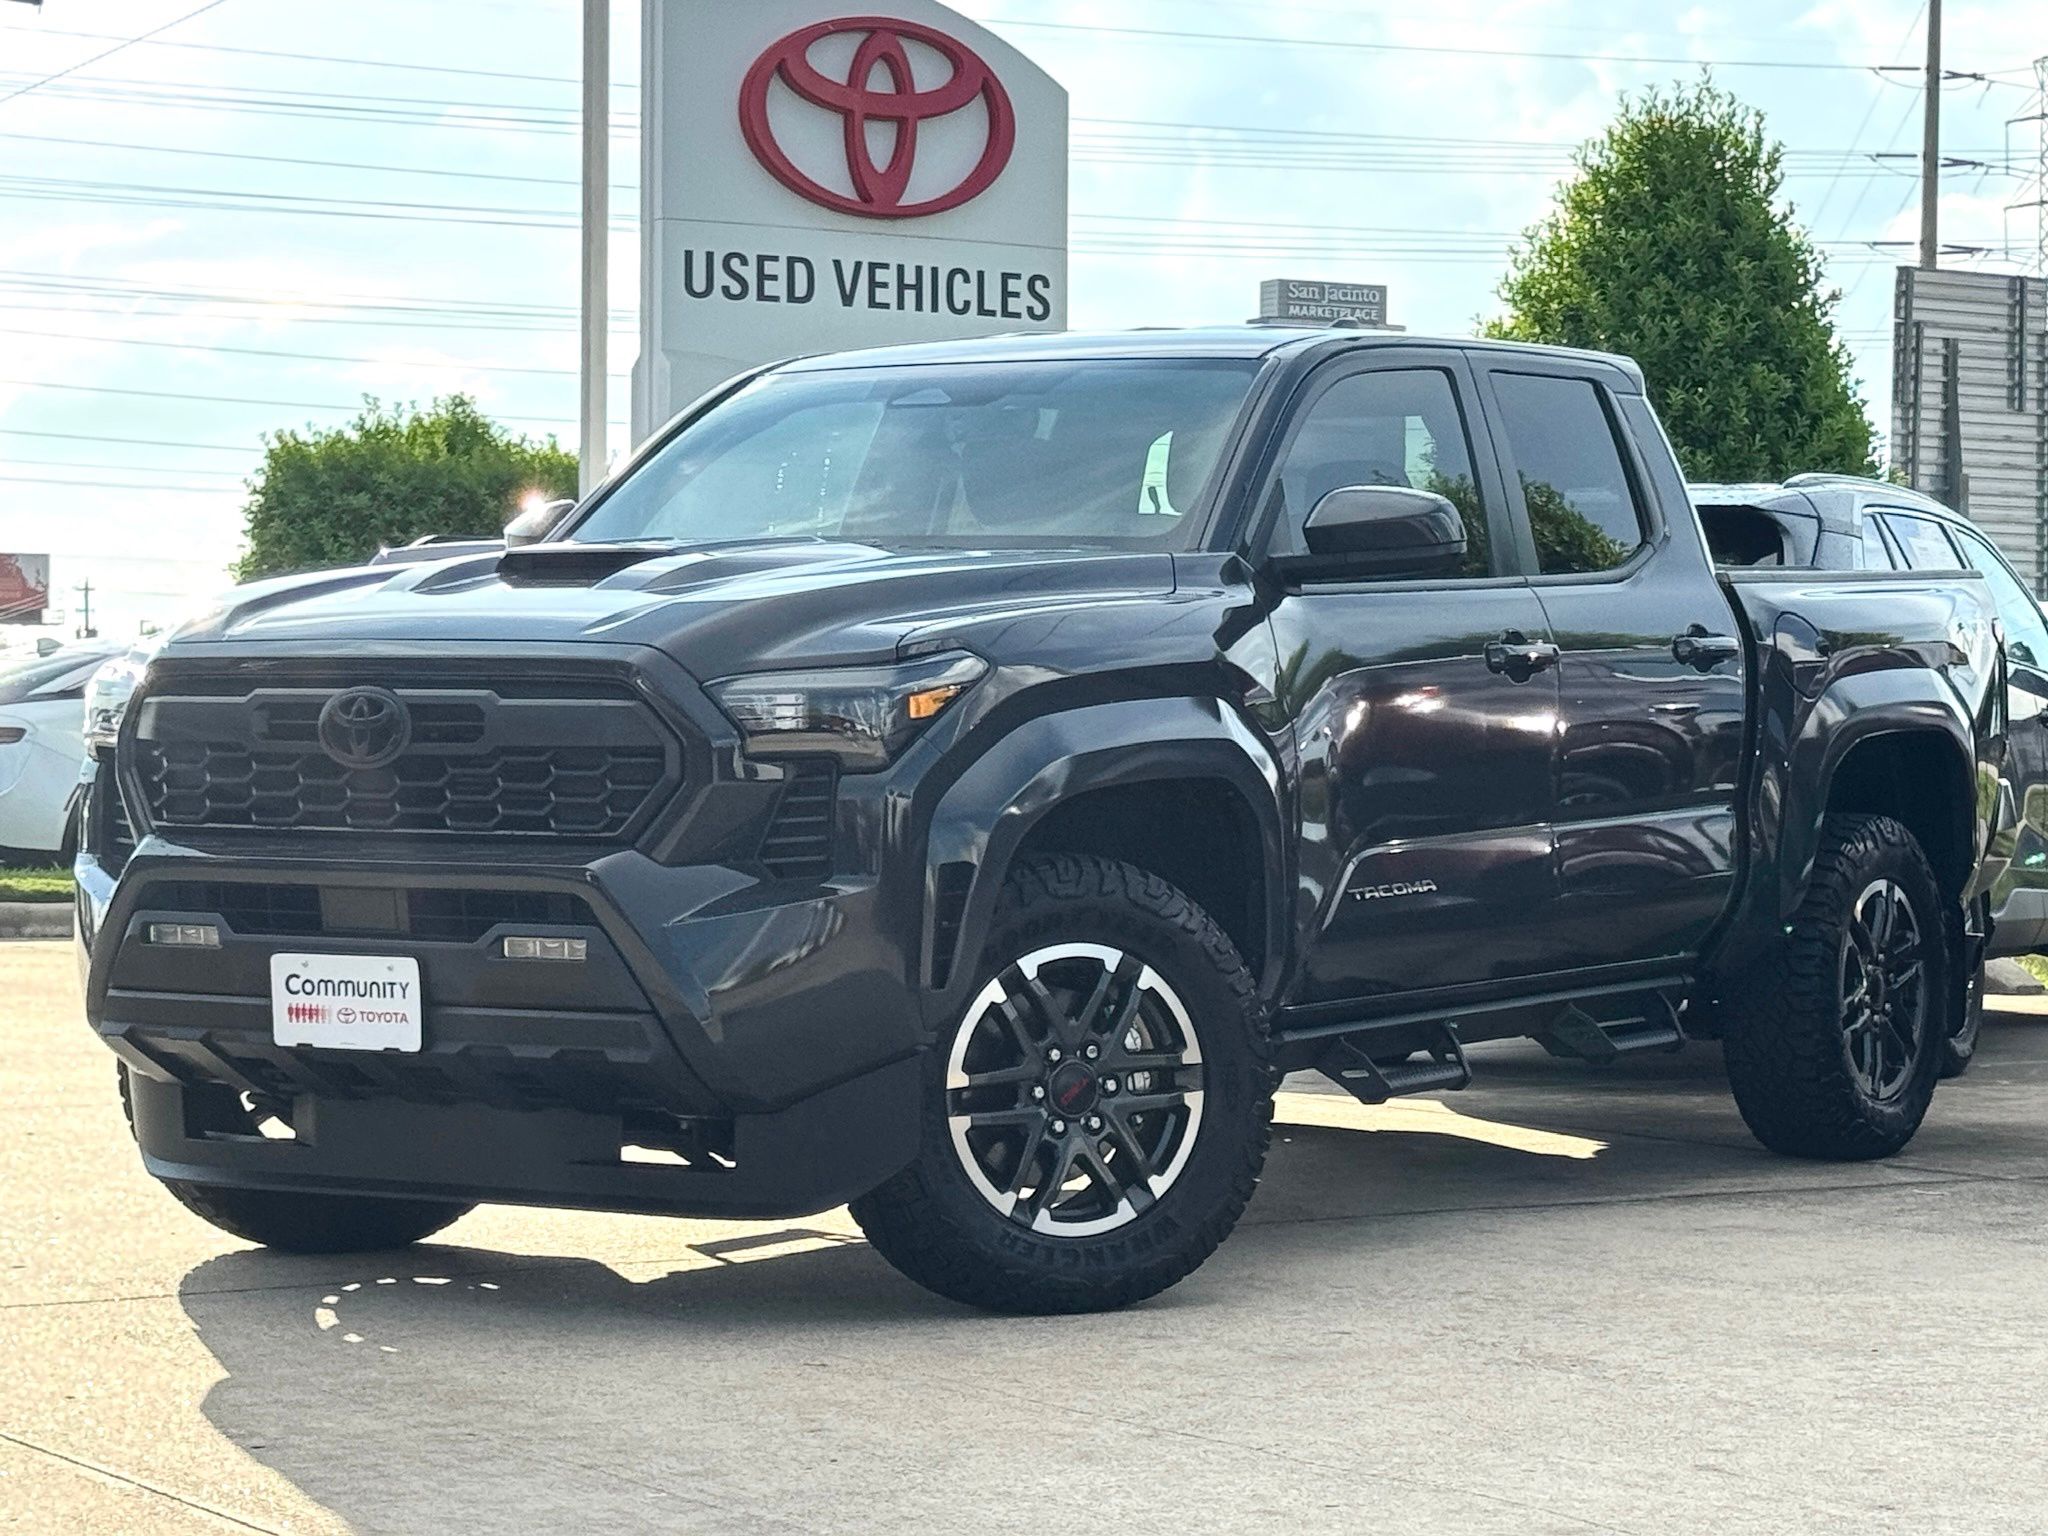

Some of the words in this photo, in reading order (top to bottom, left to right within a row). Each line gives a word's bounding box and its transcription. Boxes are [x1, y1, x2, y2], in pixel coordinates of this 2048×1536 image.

[683, 249, 816, 304] USED
[832, 258, 1051, 321] VEHICLES
[1288, 282, 1320, 299] San
[1321, 284, 1380, 304] Jacinto
[1288, 305, 1379, 320] MARKETPLACE
[1346, 879, 1438, 901] TACOMA
[359, 1010, 409, 1025] TOYOTA
